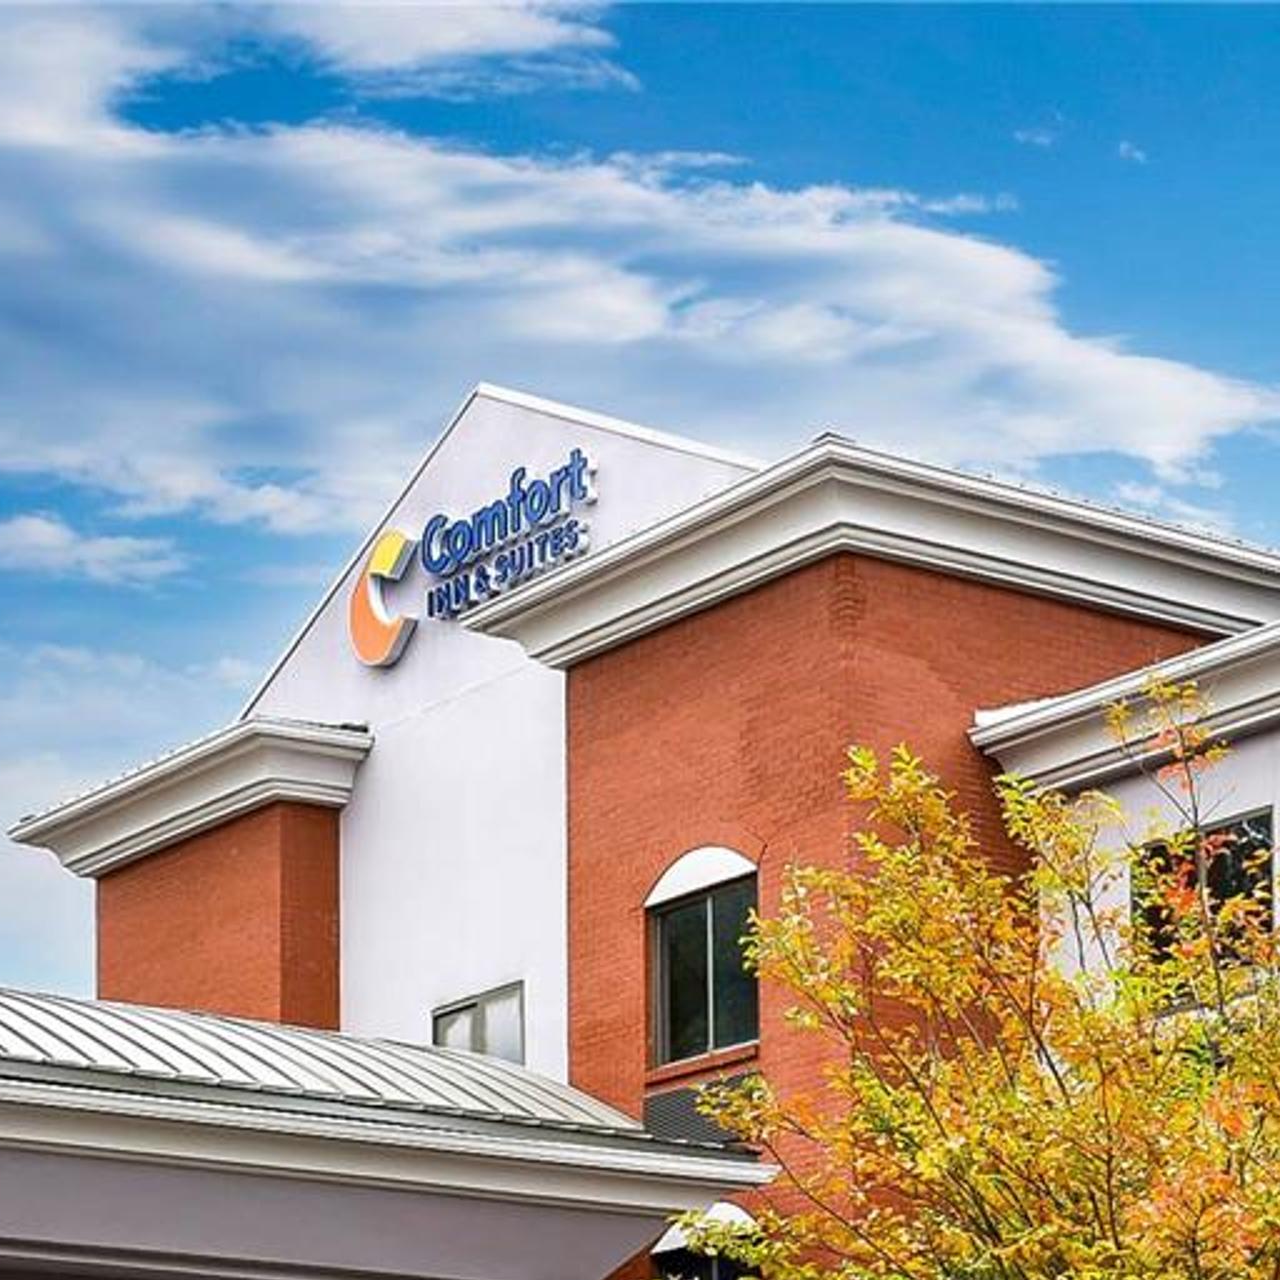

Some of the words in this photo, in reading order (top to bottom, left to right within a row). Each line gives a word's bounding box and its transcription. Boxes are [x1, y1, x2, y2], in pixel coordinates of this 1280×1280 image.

[422, 448, 588, 575] Comfort
[427, 574, 470, 618] INN
[494, 519, 580, 584] SUITES
